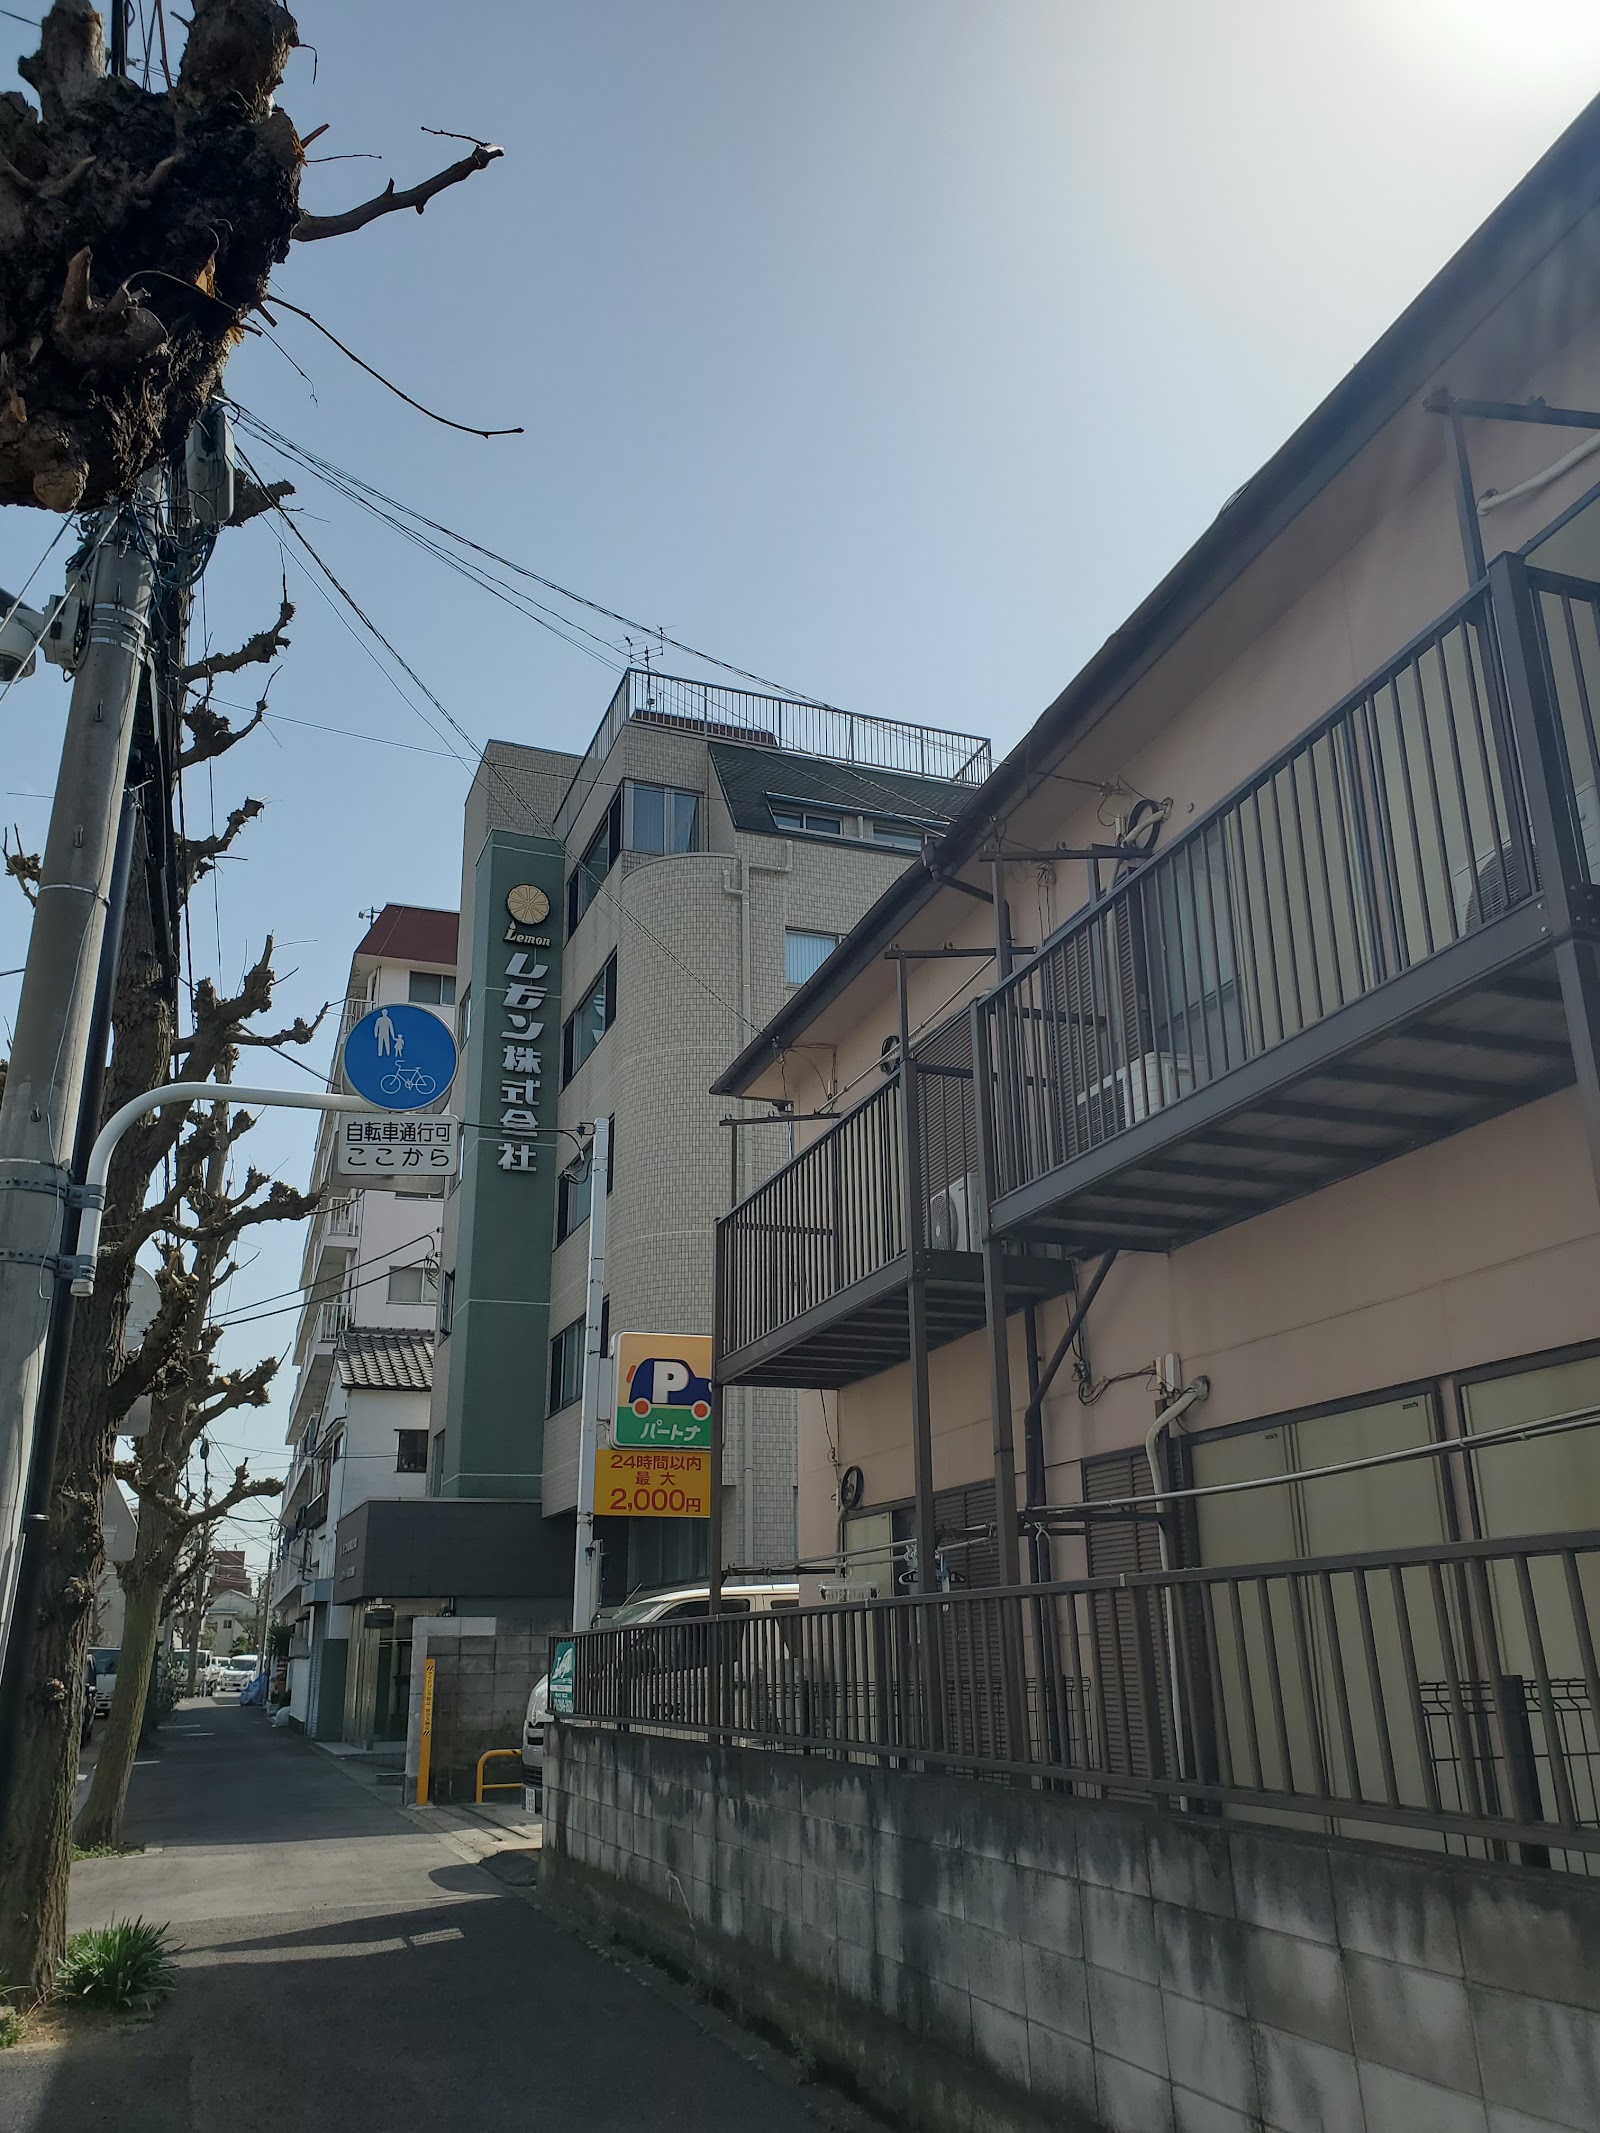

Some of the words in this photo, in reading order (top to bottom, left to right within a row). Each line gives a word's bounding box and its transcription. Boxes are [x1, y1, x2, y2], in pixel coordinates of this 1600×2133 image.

[504, 923, 551, 947] Lemon
[497, 952, 549, 1172] レモン株式会社
[346, 1121, 451, 1143] 自転車通行可
[347, 1147, 450, 1168] ここから
[652, 1360, 690, 1404] P
[610, 1454, 702, 1471] 24時間以内
[610, 1488, 701, 1513] 2,000円
